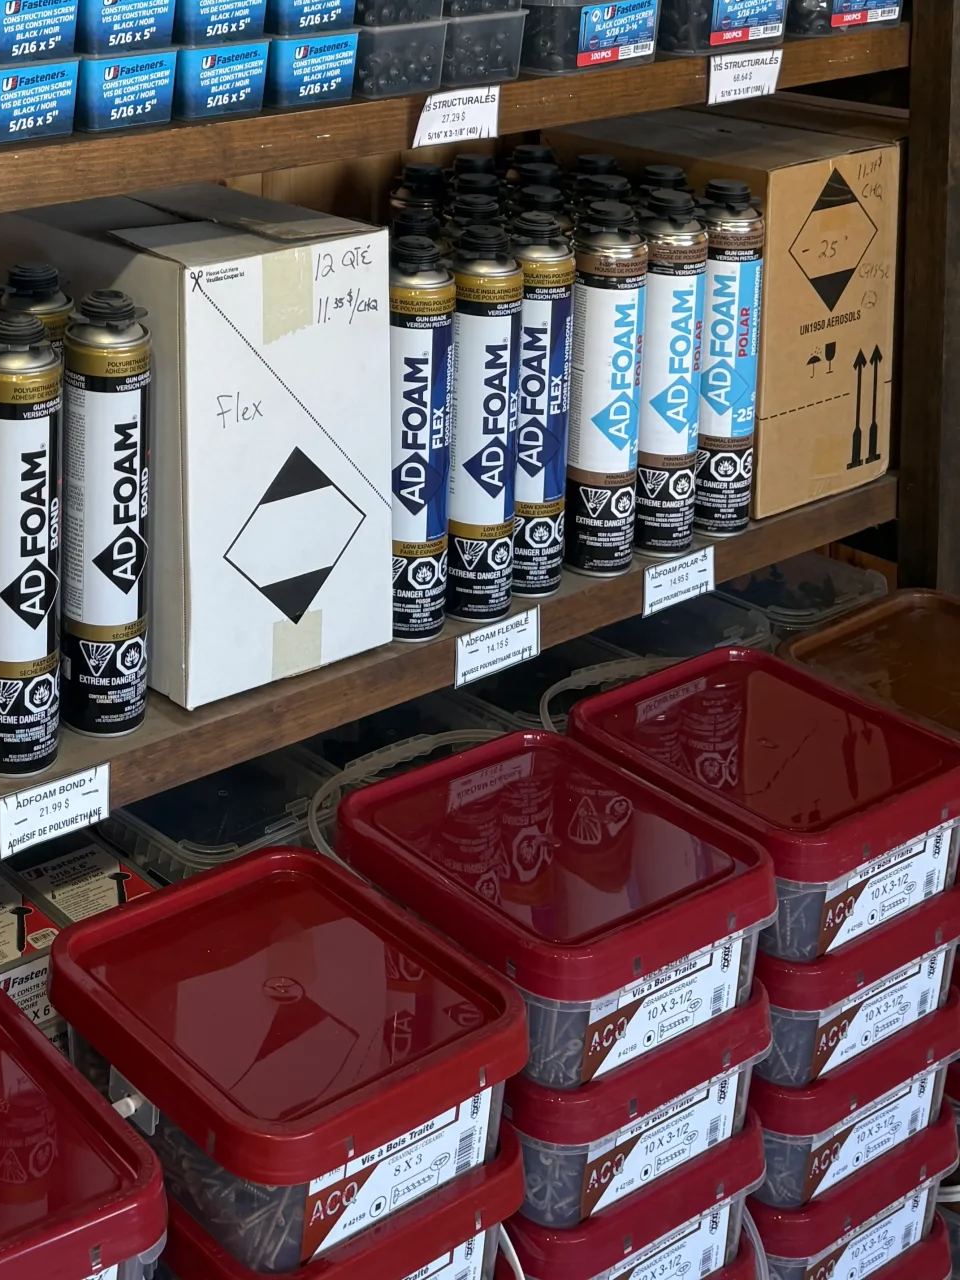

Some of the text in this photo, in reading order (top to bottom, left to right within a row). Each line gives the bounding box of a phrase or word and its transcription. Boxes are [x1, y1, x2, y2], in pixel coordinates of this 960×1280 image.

[714, 57, 778, 71] VIS STRUCTURALES
[433, 95, 495, 110] STRUCTURALES
[442, 112, 465, 123] 27.29 $
[467, 126, 478, 136] (40)
[315, 253, 335, 281] 12
[738, 307, 750, 358] POLAR
[800, 310, 861, 335] UN1950 AEROSOLS
[706, 274, 737, 406] ADFOAM
[549, 374, 562, 414] FLEX
[651, 566, 677, 580] ADFOAM
[678, 558, 698, 570] POLAR
[670, 575, 684, 586] 14.95
[465, 617, 529, 647] ADFOAM FLEXIBLE
[487, 638, 508, 653] 14.15 $
[16, 789, 56, 810] ADFOAM
[59, 779, 85, 794] BOND
[40, 799, 69, 817] 21.99 $
[8, 807, 102, 849] ADHÉSIF DE POLYURÉTHANE
[648, 990, 693, 1021] 10 X 3-1/2
[361, 1154, 375, 1166] Vis
[386, 1137, 406, 1153] Bois
[408, 1120, 435, 1139] Traité
[394, 1154, 423, 1177] 8 X 3
[309, 1182, 359, 1226] ACQ
